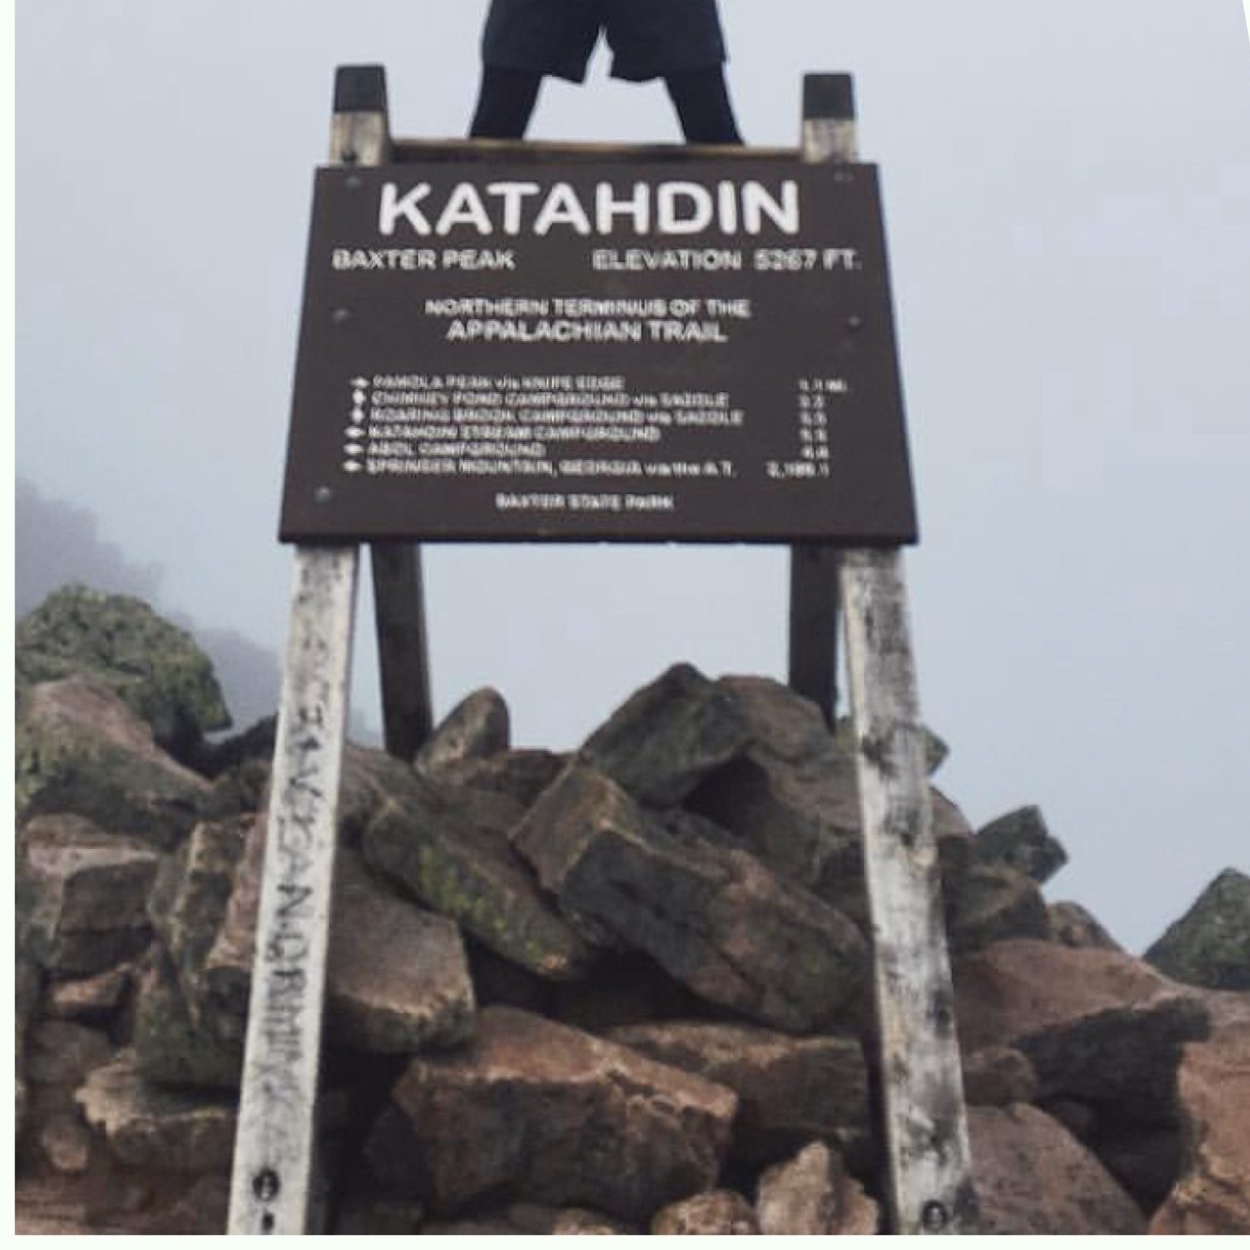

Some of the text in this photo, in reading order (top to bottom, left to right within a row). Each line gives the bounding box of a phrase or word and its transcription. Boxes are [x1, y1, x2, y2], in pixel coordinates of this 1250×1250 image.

[378, 180, 800, 235] KATAHDIN
[331, 248, 516, 271] BAXTER PEAK
[591, 248, 743, 271] ELEVATION
[822, 248, 863, 271] FT.
[424, 297, 752, 319] NORTHERN TERMINUS OF THE
[446, 319, 729, 343] APPALACHIAN TRAIL
